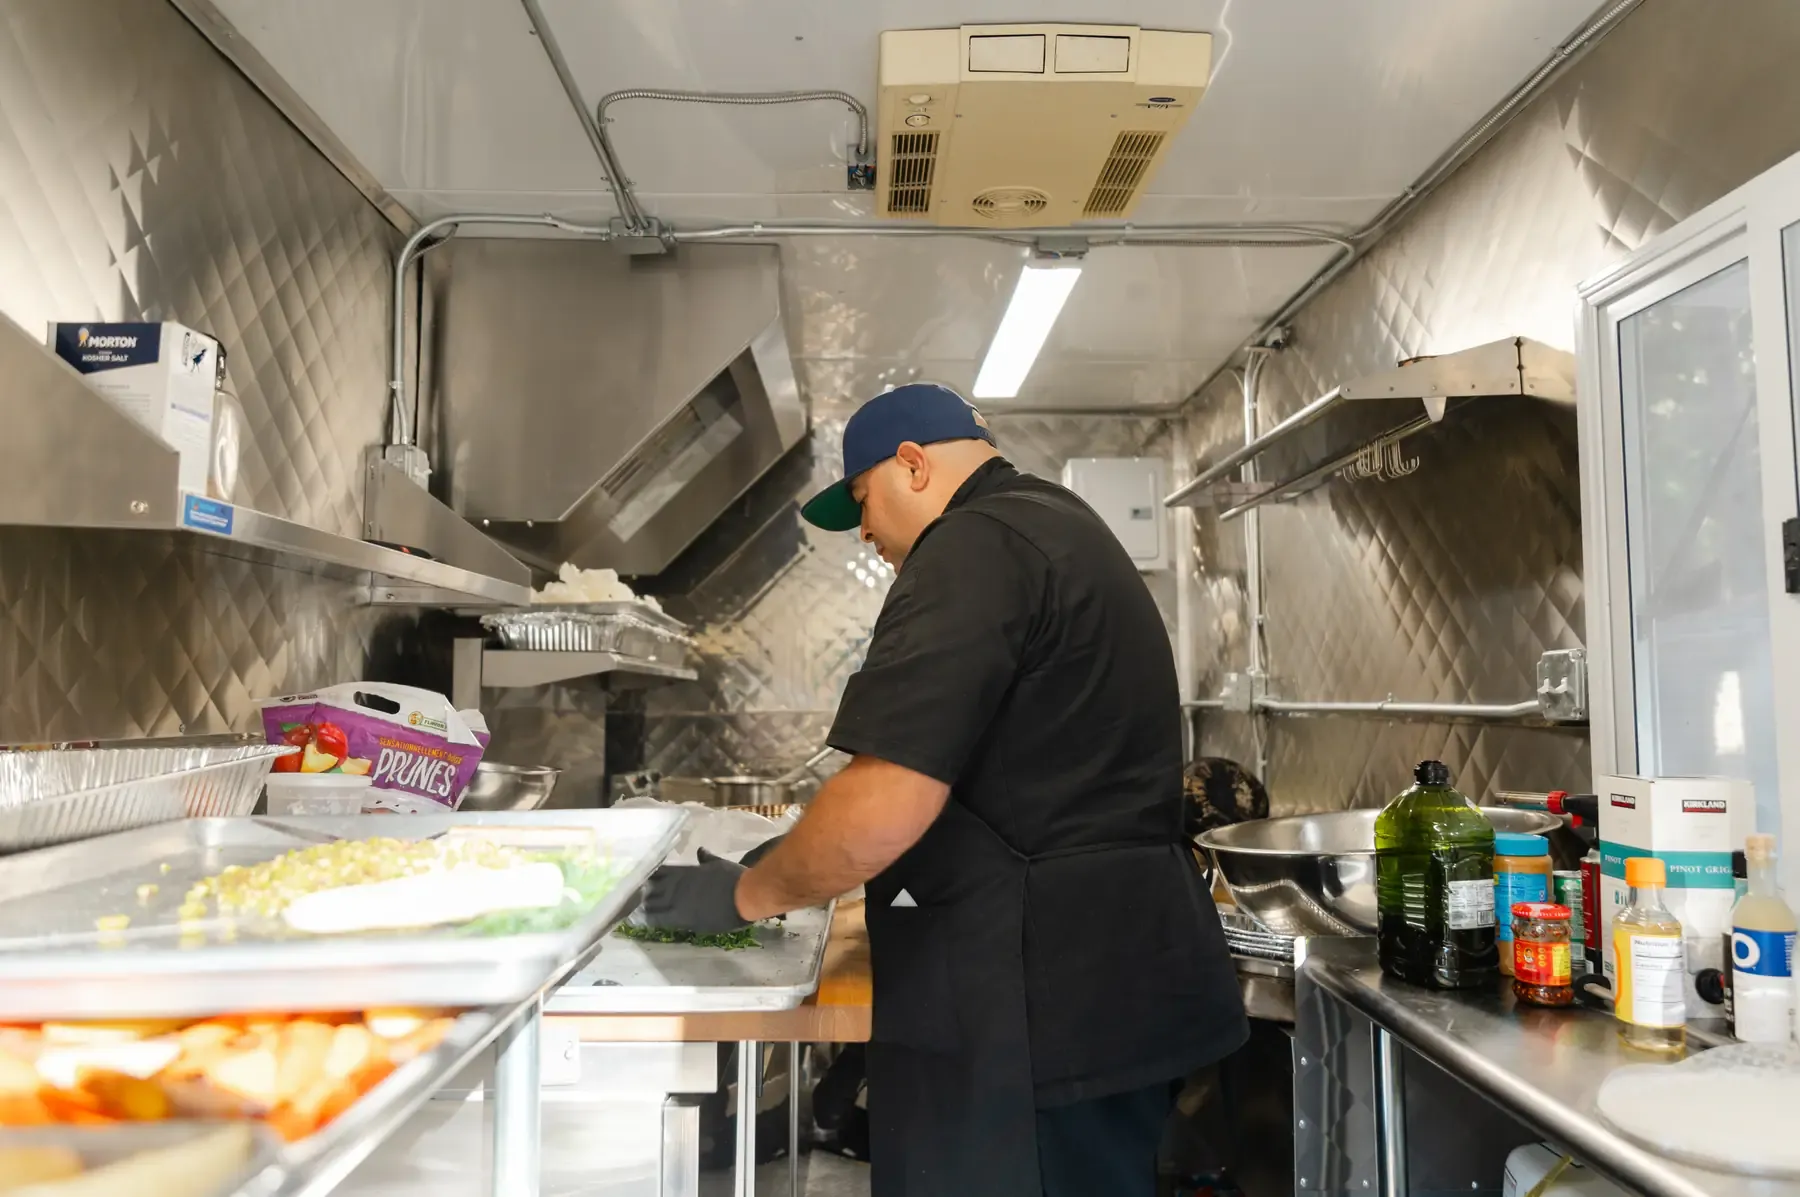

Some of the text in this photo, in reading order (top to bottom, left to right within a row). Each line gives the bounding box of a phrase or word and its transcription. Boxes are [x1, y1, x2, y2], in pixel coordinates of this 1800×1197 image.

[88, 335, 137, 348] MORTON
[82, 354, 128, 362] KOSHER SALT
[372, 747, 456, 797] PRUNES
[1683, 800, 1725, 809] KIRKLAND
[1604, 854, 1622, 865] PINOT
[1670, 865, 1732, 874] PINOT GRIG
